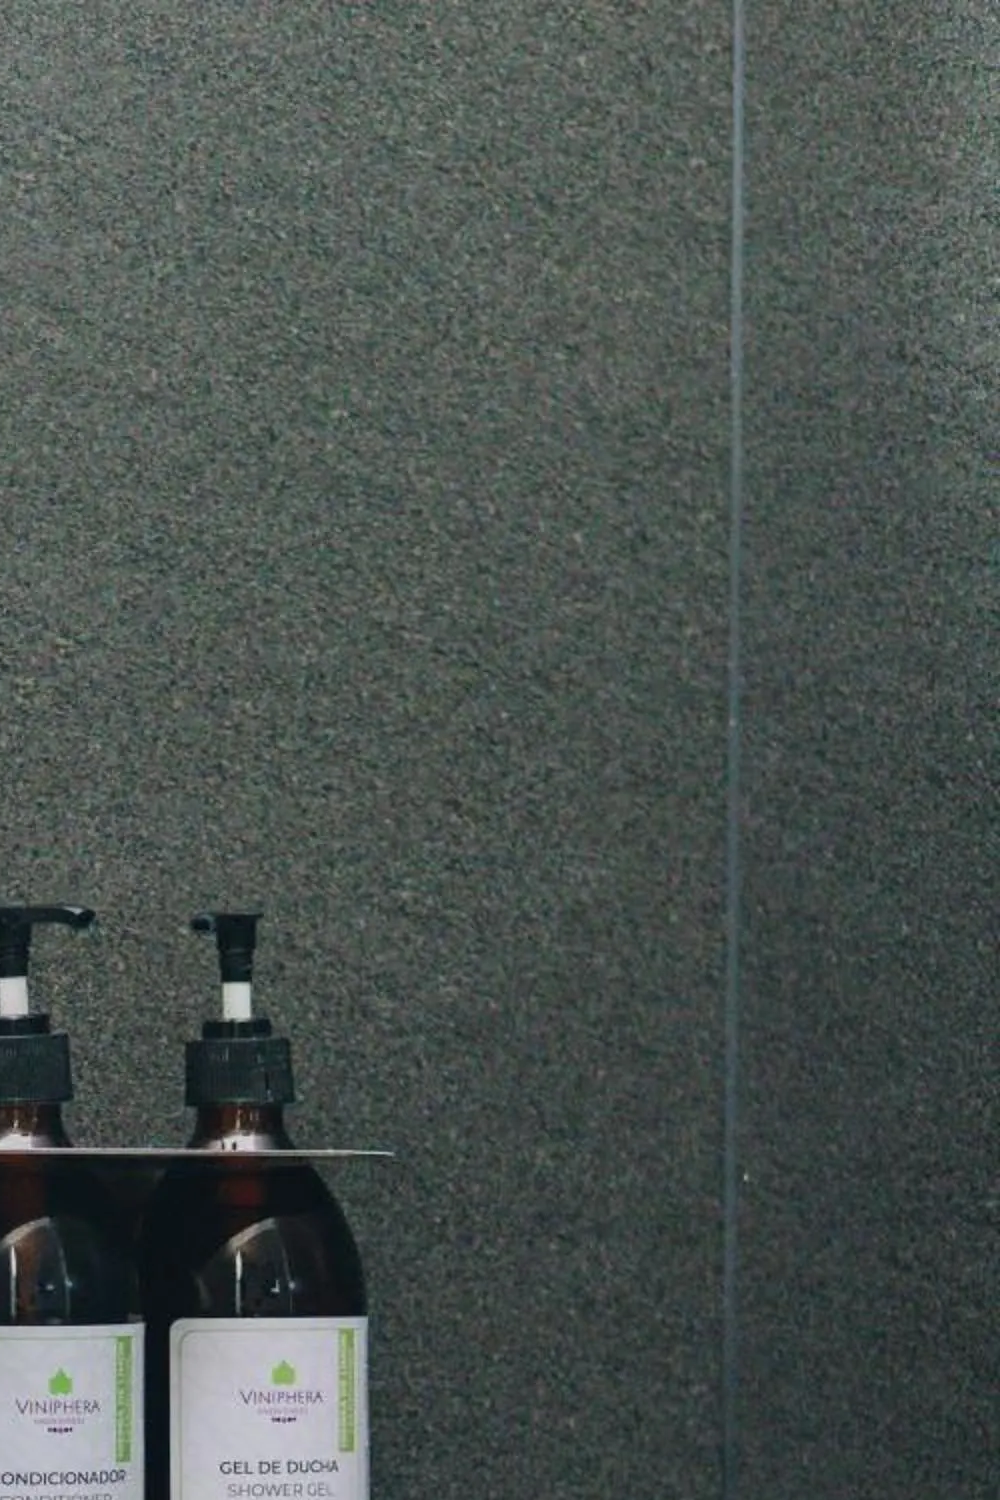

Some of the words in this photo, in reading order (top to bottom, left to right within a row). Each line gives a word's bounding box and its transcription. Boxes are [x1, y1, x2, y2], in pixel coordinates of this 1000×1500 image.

[15, 1399, 101, 1415] VINIPHERA
[219, 1460, 254, 1475] GEL
[258, 1460, 281, 1475] DE
[286, 1459, 339, 1474] DUCHA
[227, 1482, 304, 1498] SHOWER
[306, 1481, 336, 1497] GEL
